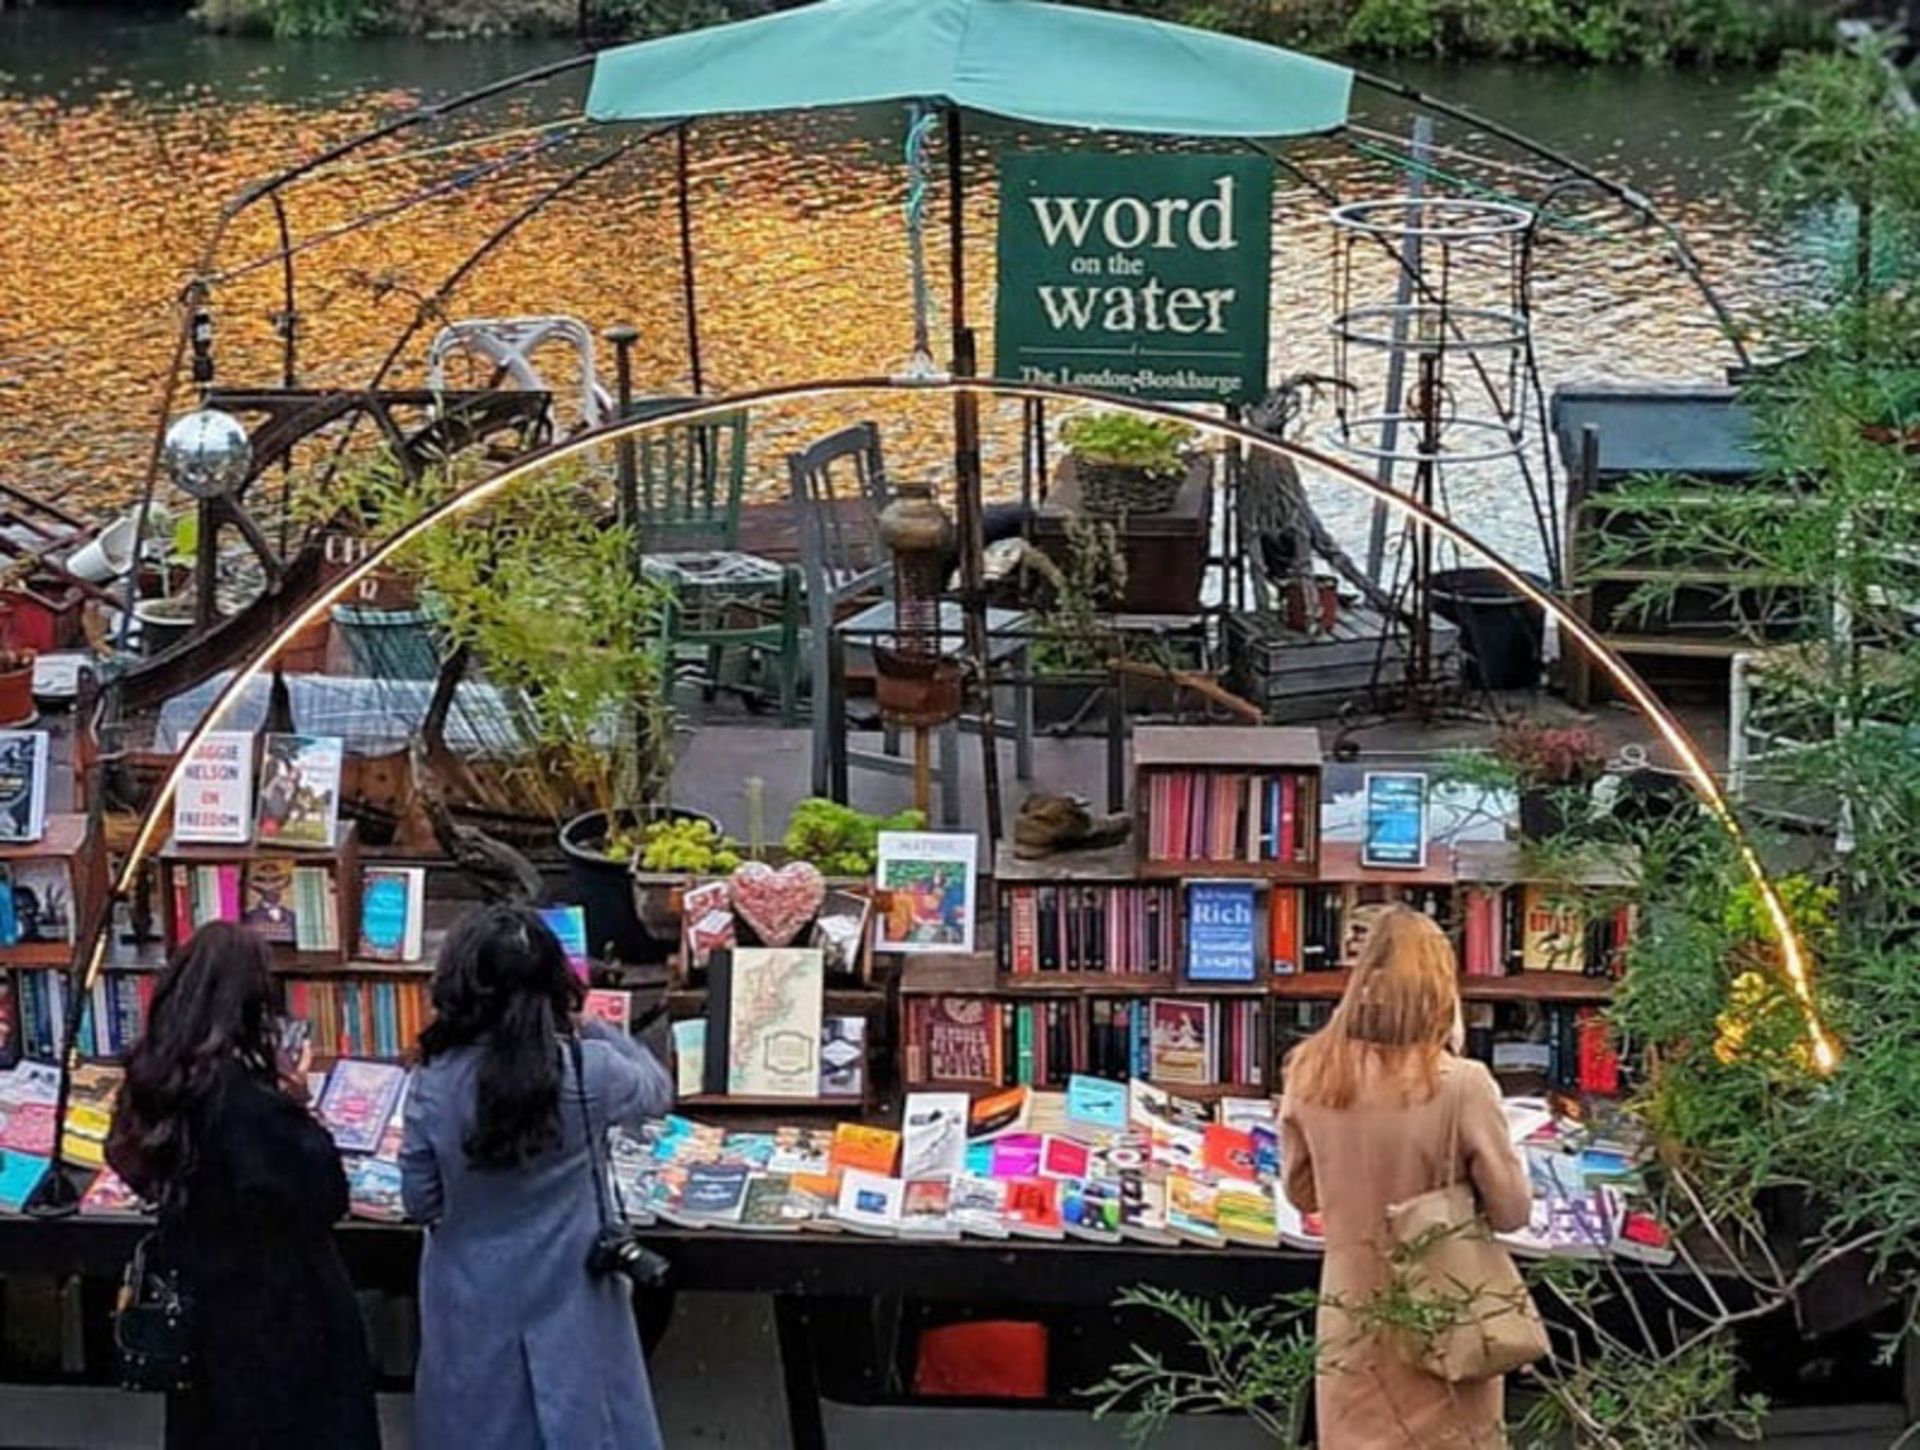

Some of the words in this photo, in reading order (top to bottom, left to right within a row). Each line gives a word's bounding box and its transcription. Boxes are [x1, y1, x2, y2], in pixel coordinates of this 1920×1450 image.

[1029, 175, 1239, 250] word
[1071, 256, 1101, 274] on
[1108, 252, 1144, 275] the
[1038, 277, 1236, 333] water
[1019, 366, 1056, 385] The
[1060, 368, 1133, 388] London
[1137, 370, 1243, 394] Bookbarge
[179, 812, 239, 827] FREEDOM
[1192, 902, 1251, 924] Rich
